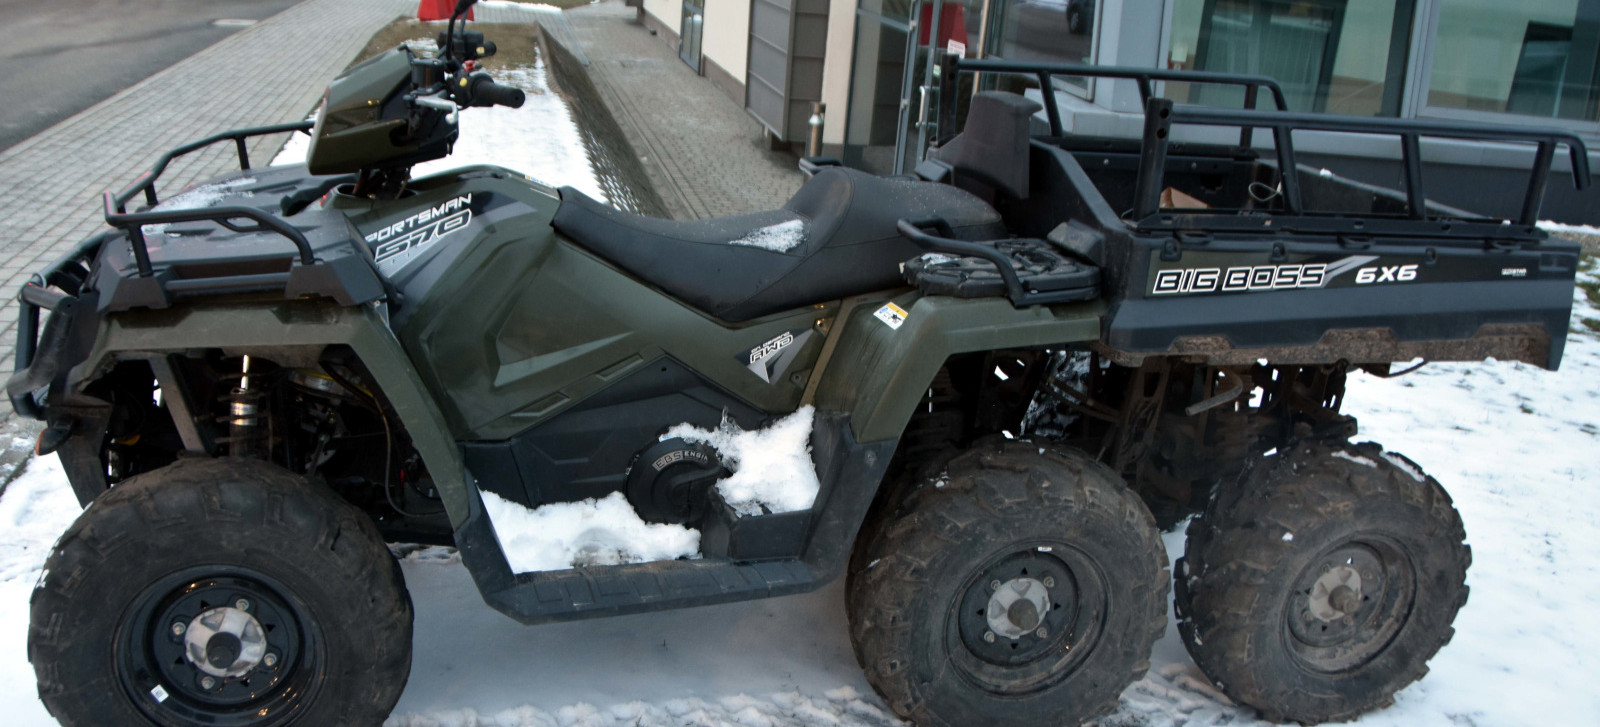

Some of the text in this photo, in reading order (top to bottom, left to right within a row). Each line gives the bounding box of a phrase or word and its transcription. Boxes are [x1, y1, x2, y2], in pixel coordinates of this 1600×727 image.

[365, 193, 472, 242] PORTSMAN
[374, 208, 472, 264] 570
[1152, 263, 1418, 294] BIG BOSS 6X6
[750, 334, 793, 363] AWD
[655, 451, 681, 468] EBS
